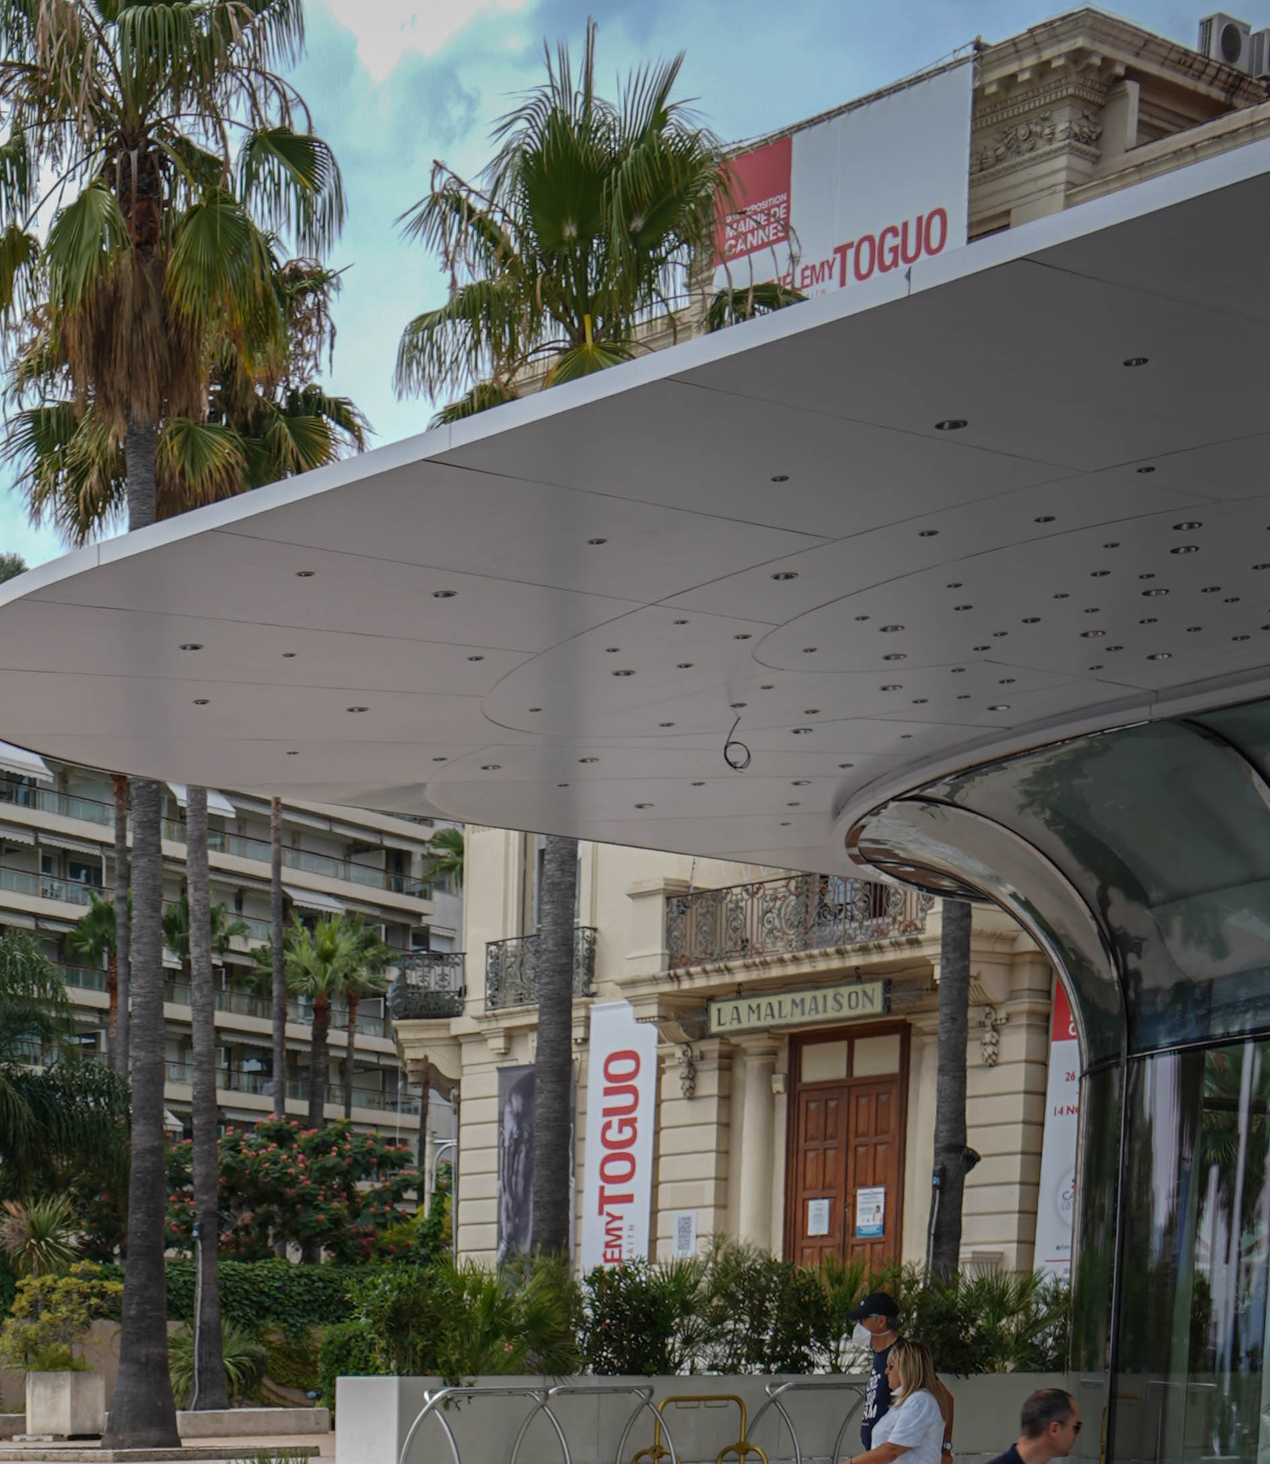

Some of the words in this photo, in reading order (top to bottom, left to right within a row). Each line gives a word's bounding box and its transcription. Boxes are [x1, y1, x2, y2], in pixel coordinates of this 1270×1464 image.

[770, 203, 788, 223] DE
[724, 221, 787, 257] CANNES
[833, 206, 948, 288] TOGUO
[716, 1005, 742, 1027] LA
[747, 987, 875, 1023] MALMAISON
[1065, 1071, 1076, 1082] 26
[597, 1049, 641, 1216] TOGUO
[602, 1211, 624, 1272] ÉMY
